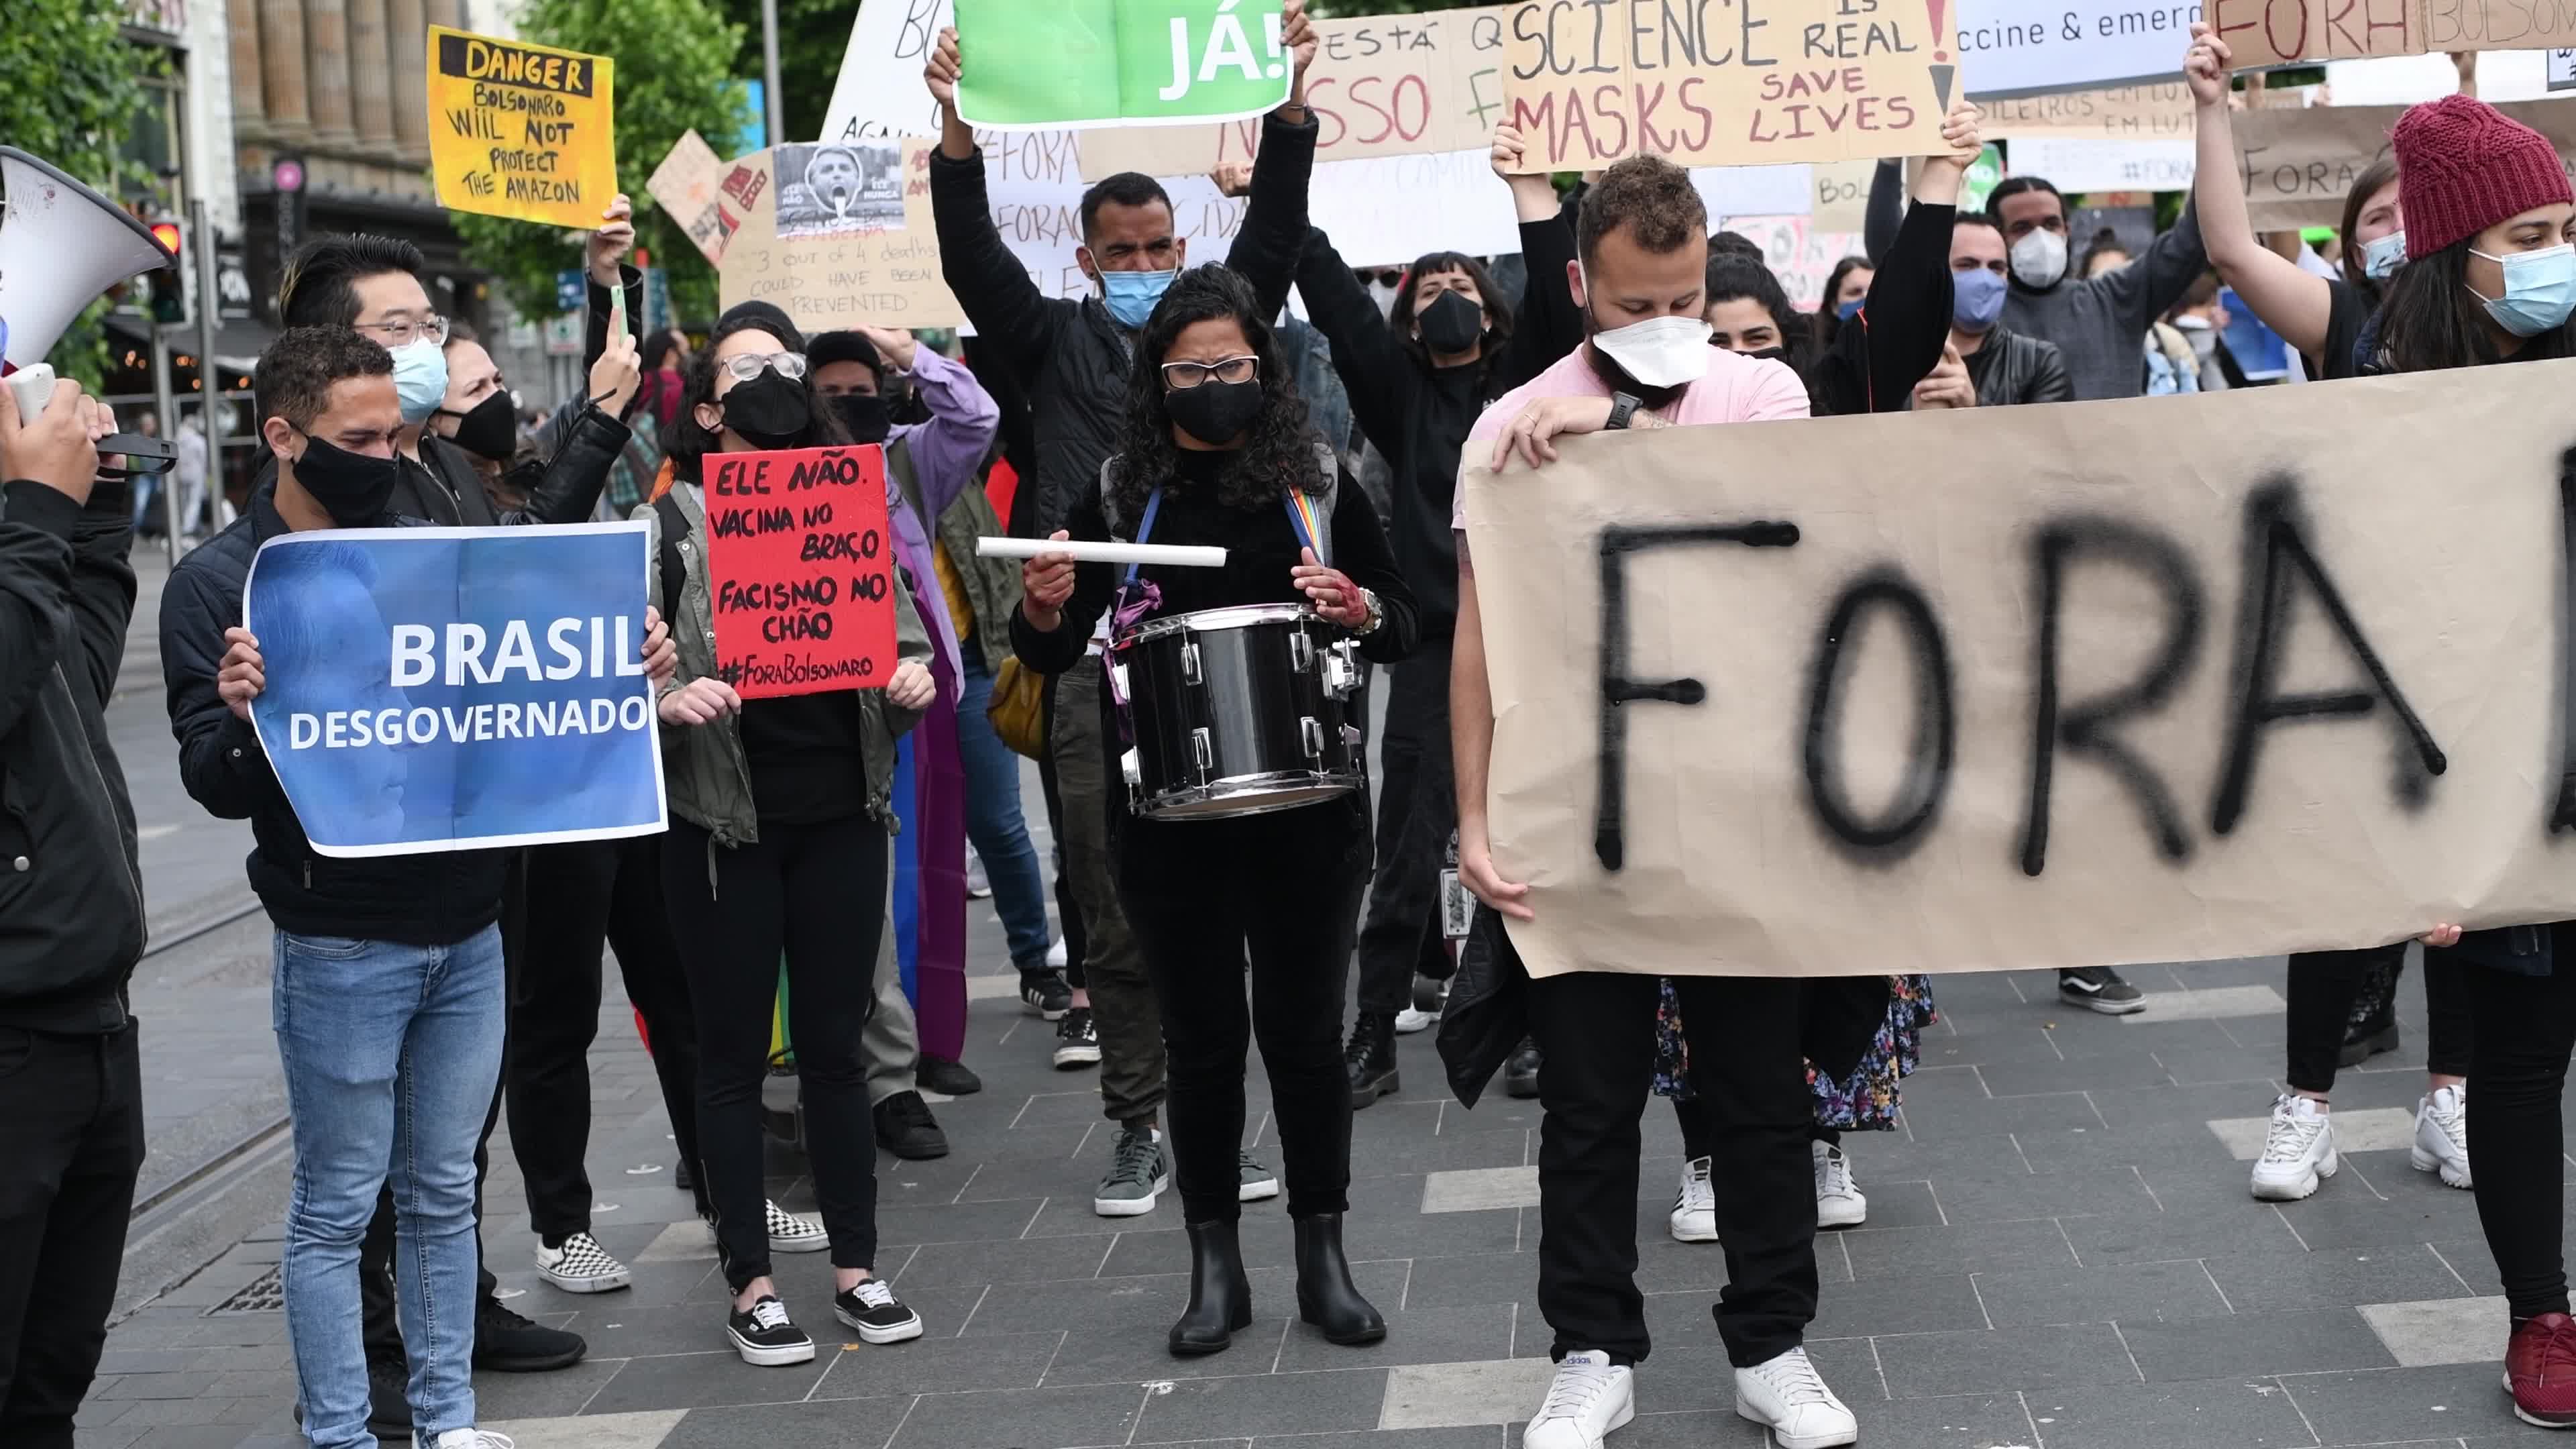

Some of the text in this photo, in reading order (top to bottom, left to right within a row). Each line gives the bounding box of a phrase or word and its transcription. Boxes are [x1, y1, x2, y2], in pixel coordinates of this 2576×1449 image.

[1326, 16, 1503, 60] ESTÁ Q
[1512, 0, 1778, 80] SCIENCE
[1803, 22, 1918, 59] REAL
[2061, 11, 2082, 41] &
[466, 41, 584, 91] DANGER
[1159, 0, 1288, 101] JÁ!
[473, 83, 566, 117] BOLSONARO
[1760, 67, 1867, 101] SAVE
[525, 119, 575, 148] NOT
[1513, 77, 1713, 170] MASKS
[1749, 97, 1916, 142] LIVES
[490, 147, 558, 173] PROTECT
[2243, 146, 2357, 197] FORA
[462, 170, 580, 204] THE AMAZON
[828, 245, 848, 264] of
[856, 243, 868, 264] 4
[881, 235, 936, 262] deaths
[749, 268, 932, 297] COULD HAVE BEEN
[716, 450, 868, 496] ELE NÃO.
[710, 502, 833, 537] VACINA NO
[800, 529, 879, 564] BRAÇO
[718, 572, 887, 614] FACISMO NO
[762, 607, 833, 643] CHÃO
[390, 615, 647, 688] BRASIL
[1594, 463, 2447, 877] FORA
[290, 694, 649, 750] DESGOVERNADO
